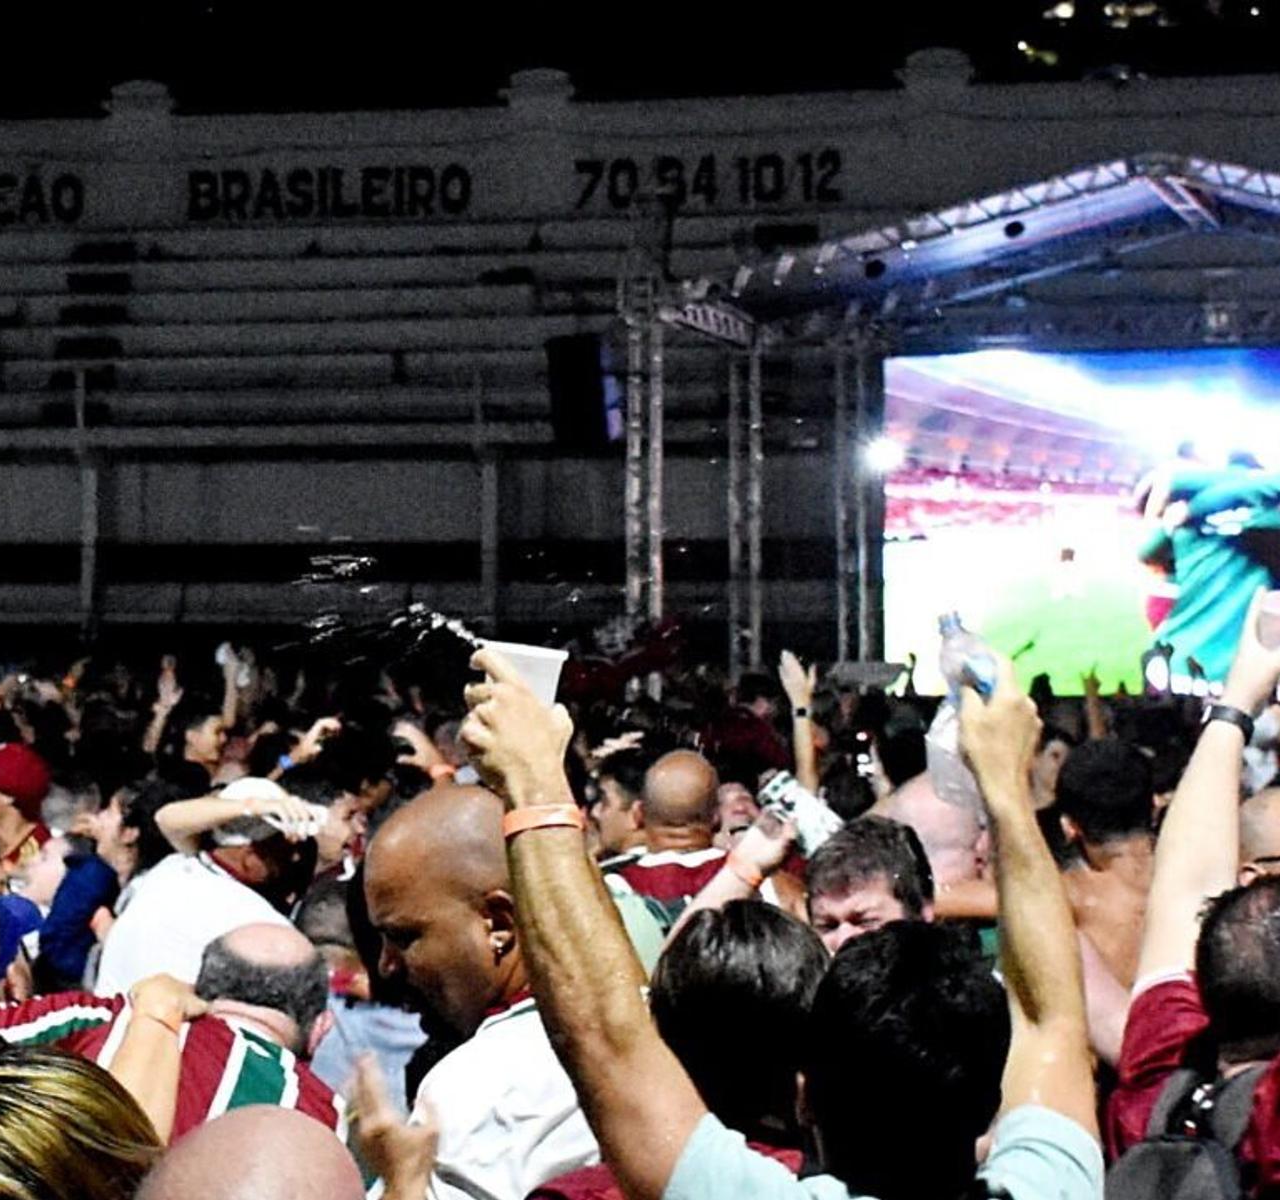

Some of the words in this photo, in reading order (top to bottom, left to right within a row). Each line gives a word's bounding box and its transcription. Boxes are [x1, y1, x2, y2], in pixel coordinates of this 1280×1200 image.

[188, 164, 470, 221] BRASILEIRO
[575, 158, 637, 209] 70
[737, 154, 784, 202] 10
[797, 149, 841, 202] 12
